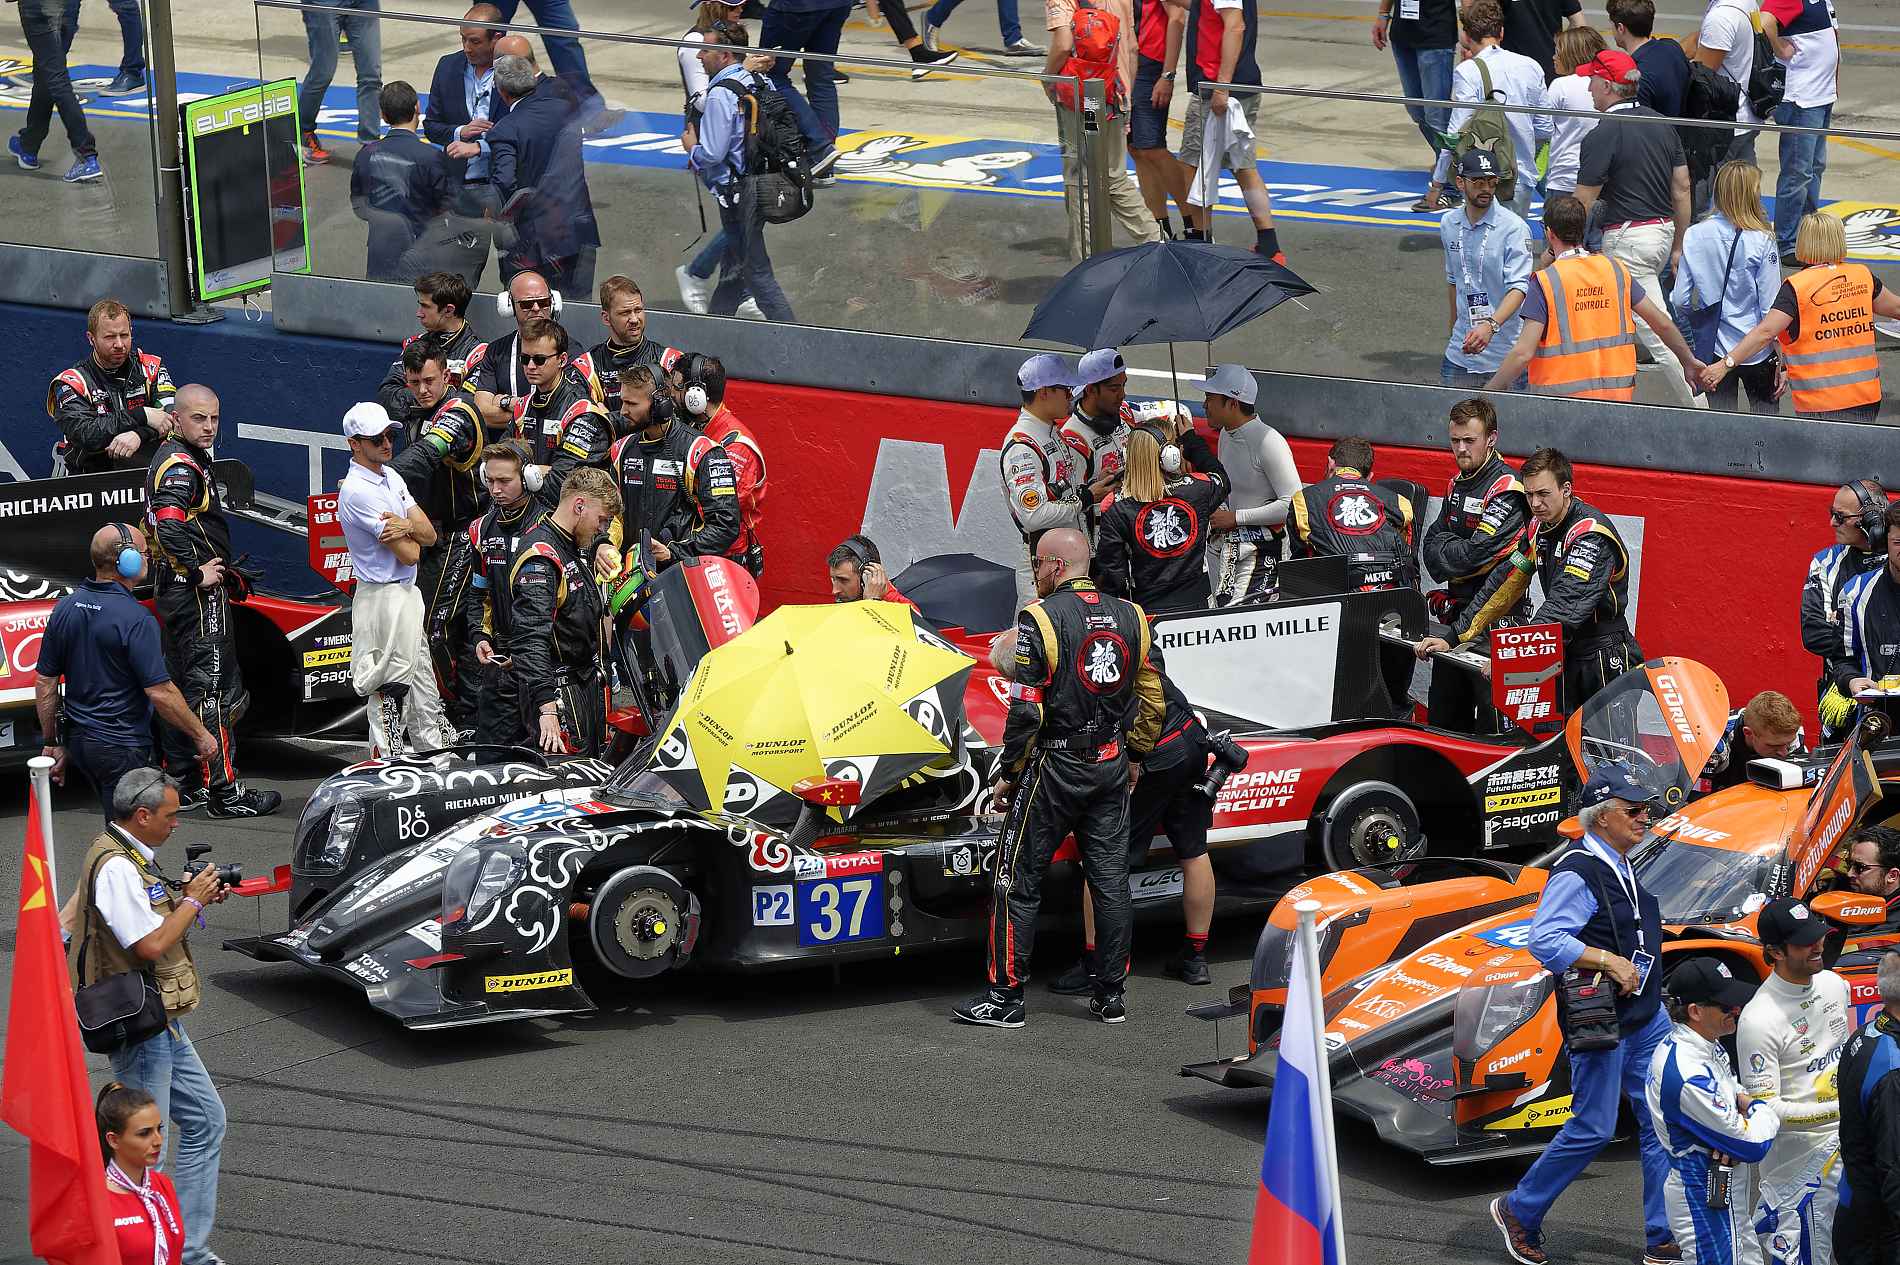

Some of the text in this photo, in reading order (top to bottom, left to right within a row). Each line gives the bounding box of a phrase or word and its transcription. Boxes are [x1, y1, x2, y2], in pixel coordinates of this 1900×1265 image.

[196, 93, 292, 133] eurasia
[1478, 155, 1492, 170] LA
[1576, 286, 1606, 299] ACCUEIL
[1820, 306, 1868, 324] ACCUEIL
[1815, 321, 1875, 341] CONTRÔLE
[0, 492, 93, 518] RICHARD
[313, 498, 339, 510] TO
[1364, 570, 1393, 584] MRTC
[704, 563, 743, 635] 道达尔
[1161, 616, 1329, 649] RICHARD MILLE
[1496, 632, 1557, 645] TOTAL
[1497, 644, 1557, 659] 道达尔
[886, 644, 902, 686] DUNLOP
[894, 650, 908, 690] MOTORSPORT
[831, 700, 876, 735] DUNLOP
[832, 708, 879, 743] MOTORSPORT
[696, 720, 730, 747] MOTORSPORT
[703, 714, 735, 742] DUNLOP
[751, 748, 805, 756] MOTORSPORT
[755, 739, 807, 749] DUNLOP
[1220, 768, 1302, 790] EPANG
[1486, 778, 1559, 793] Future Racing Media
[1216, 784, 1296, 801] ERNATIONAL
[1500, 791, 1558, 806] DUNLOP
[445, 795, 496, 811] RICHARD
[1214, 795, 1294, 814] RCUIT
[1502, 810, 1559, 830] sagcom
[829, 854, 880, 869] TOTAL
[1767, 863, 1782, 896] J.ALLEN
[756, 891, 791, 921] P2
[810, 879, 872, 941] 37
[1840, 905, 1883, 917] G-DRIVE
[357, 952, 390, 979] TOTAL
[501, 973, 569, 988] DUNLOP
[1485, 970, 1520, 983] G-DRIVE
[1355, 993, 1407, 1020] AXIS
[1488, 1048, 1531, 1073] G-DRIVE
[114, 1216, 144, 1227] MOTUL
